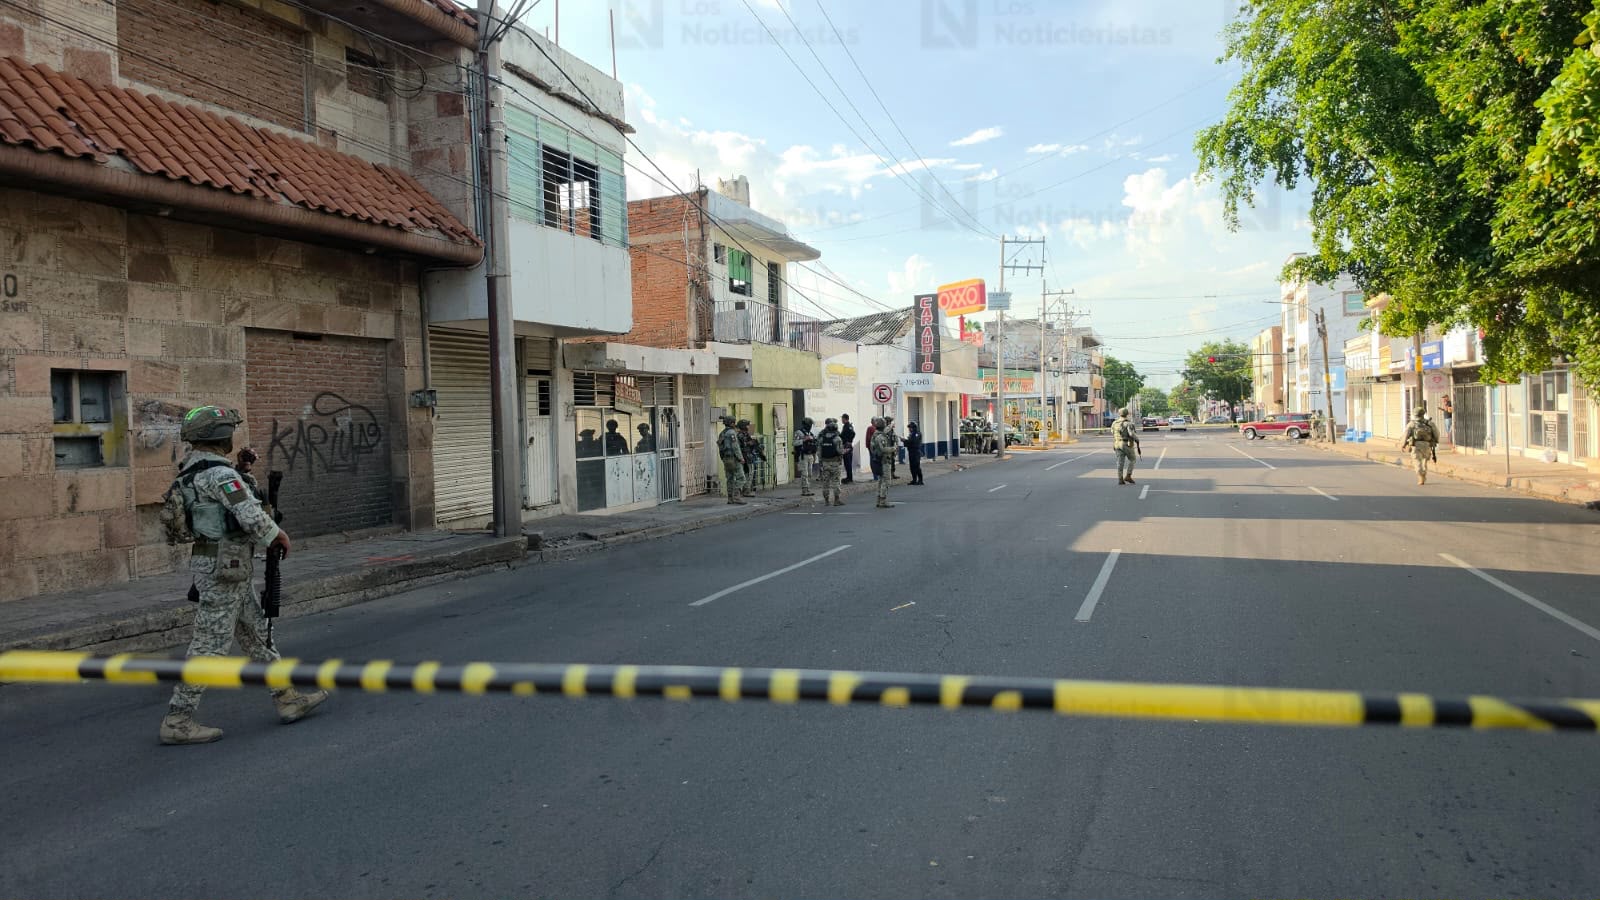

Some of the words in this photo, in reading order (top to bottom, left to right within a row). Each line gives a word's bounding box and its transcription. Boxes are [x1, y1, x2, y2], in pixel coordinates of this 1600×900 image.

[938, 286, 978, 310] OXXO
[920, 297, 933, 326] CAR
[921, 327, 934, 372] AUDIO
[1026, 408, 1052, 420] Maga
